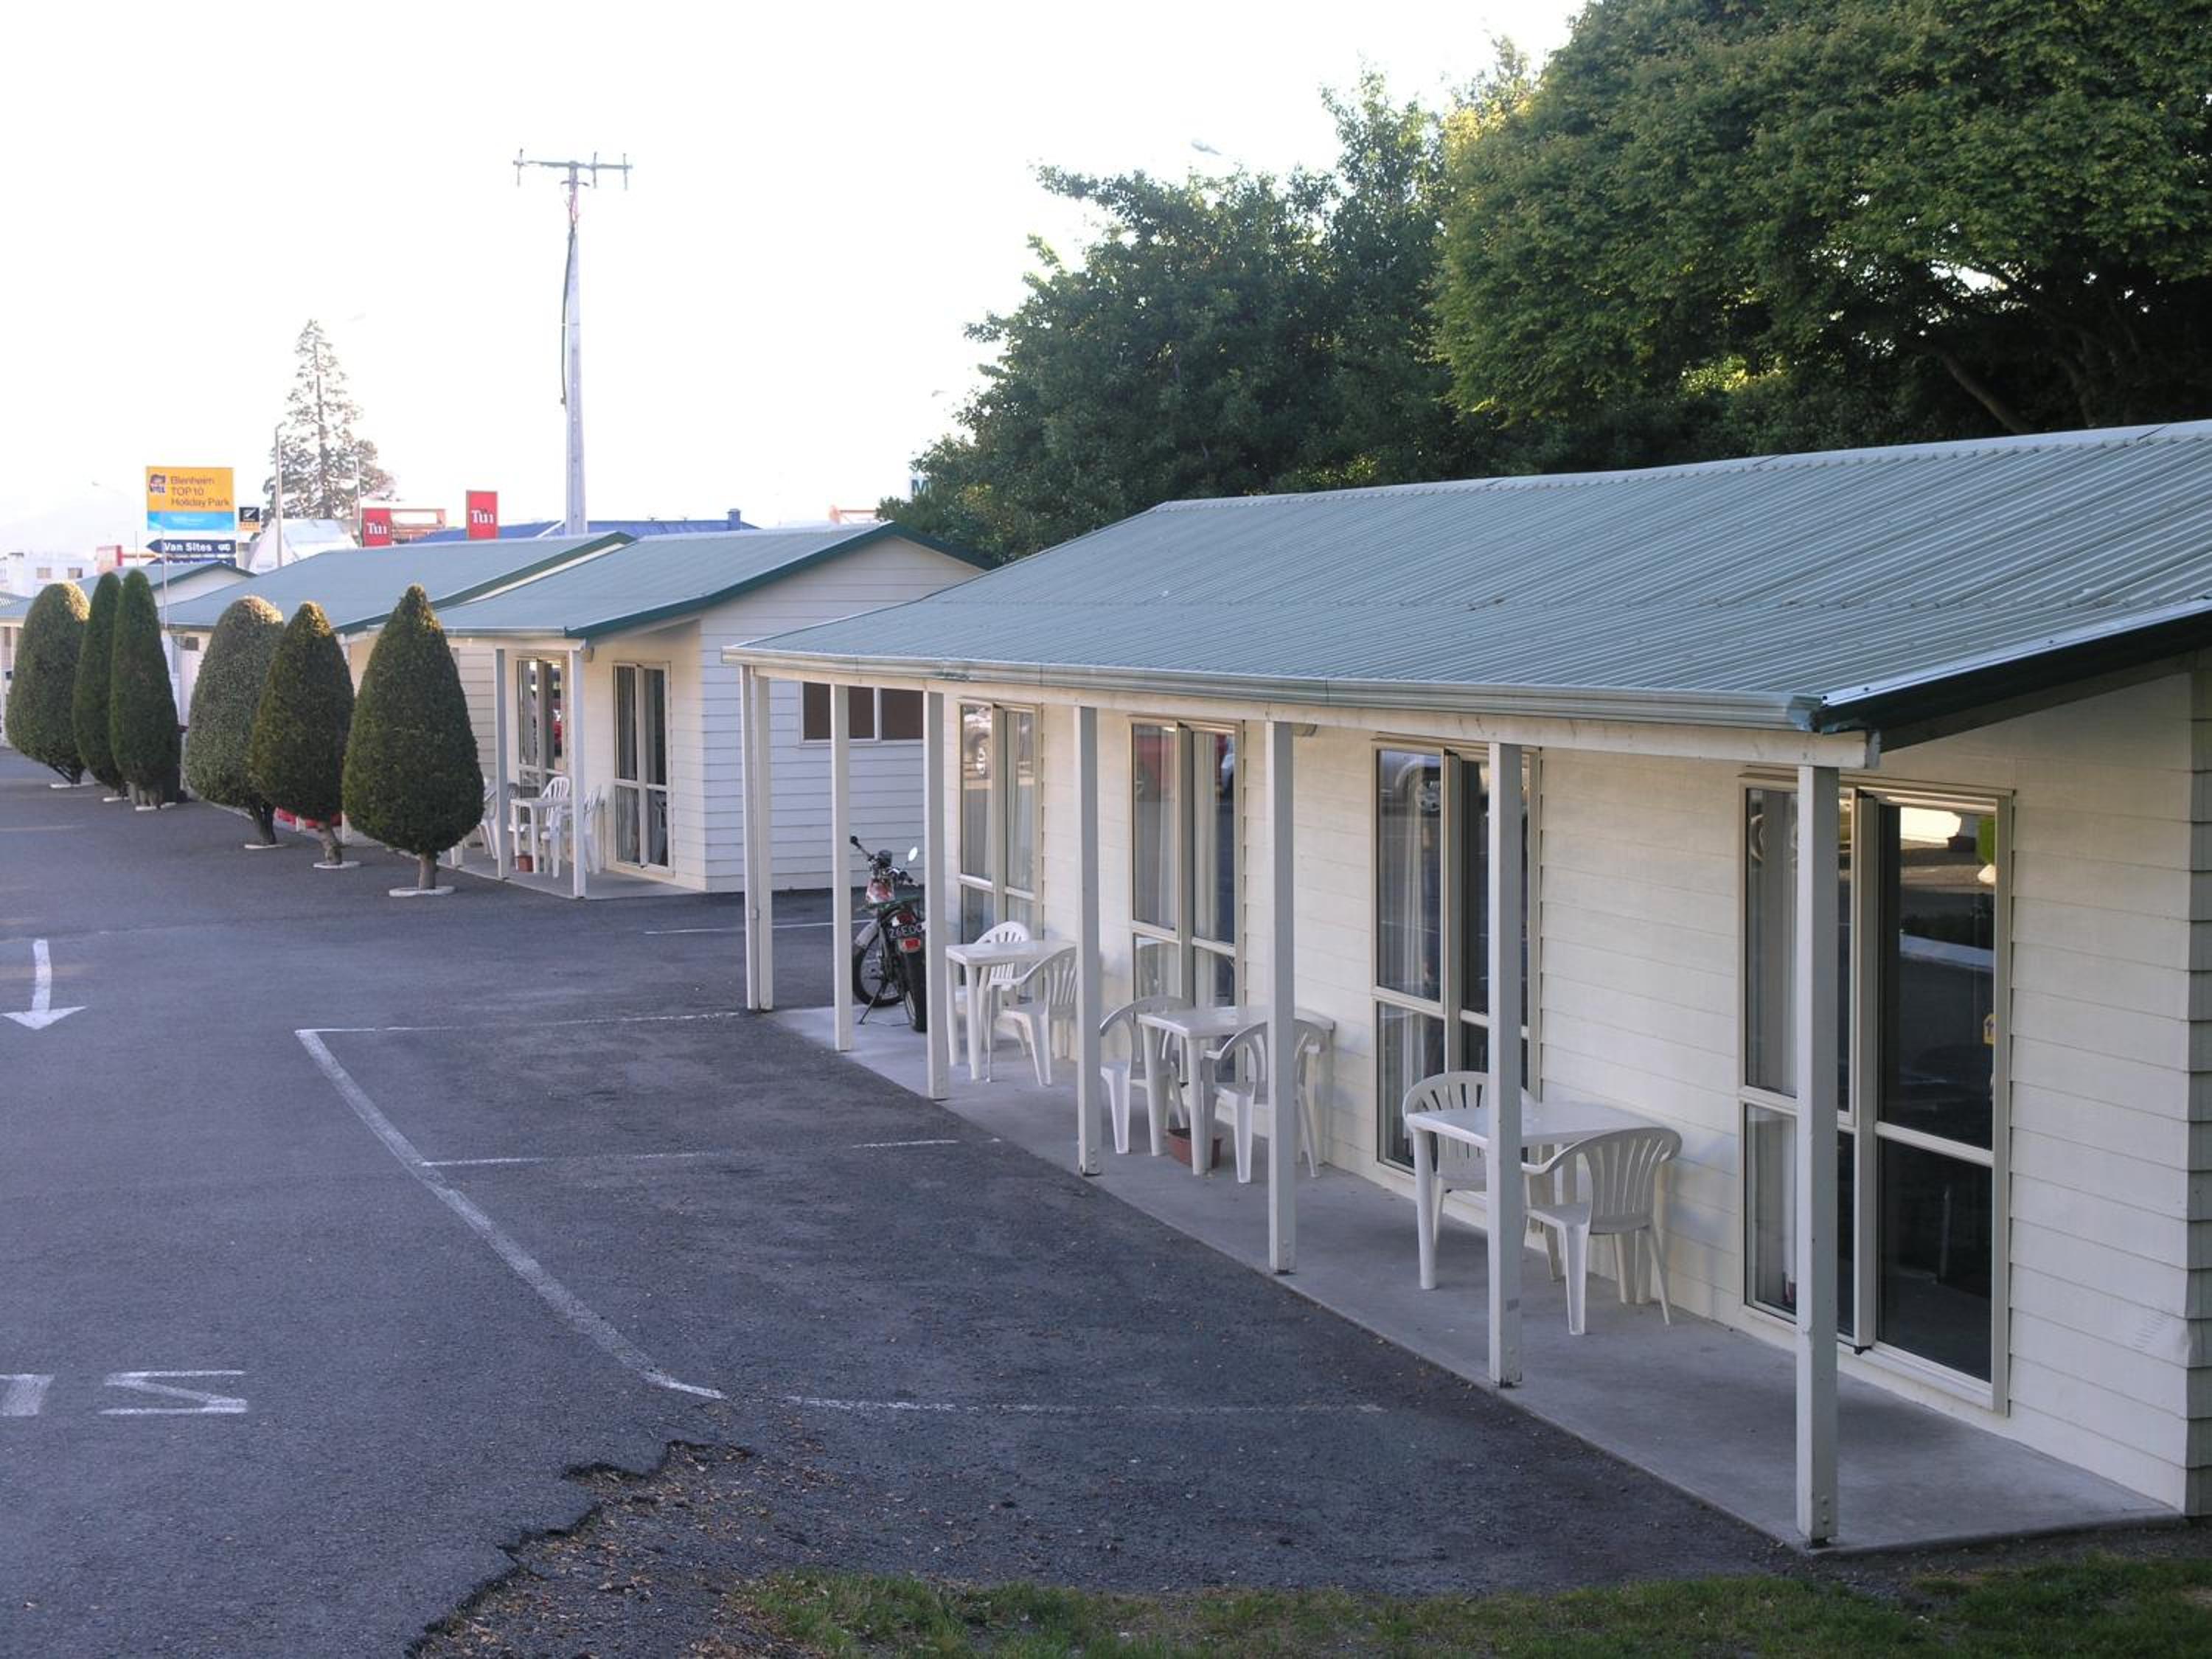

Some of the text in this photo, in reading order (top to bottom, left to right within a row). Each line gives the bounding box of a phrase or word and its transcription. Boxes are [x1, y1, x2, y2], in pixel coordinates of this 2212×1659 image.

[170, 476, 215, 484] Blenheim
[171, 487, 191, 496] TOP
[194, 487, 204, 496] 10
[171, 498, 230, 508] Holiday Park
[164, 542, 212, 552] Van Sites
